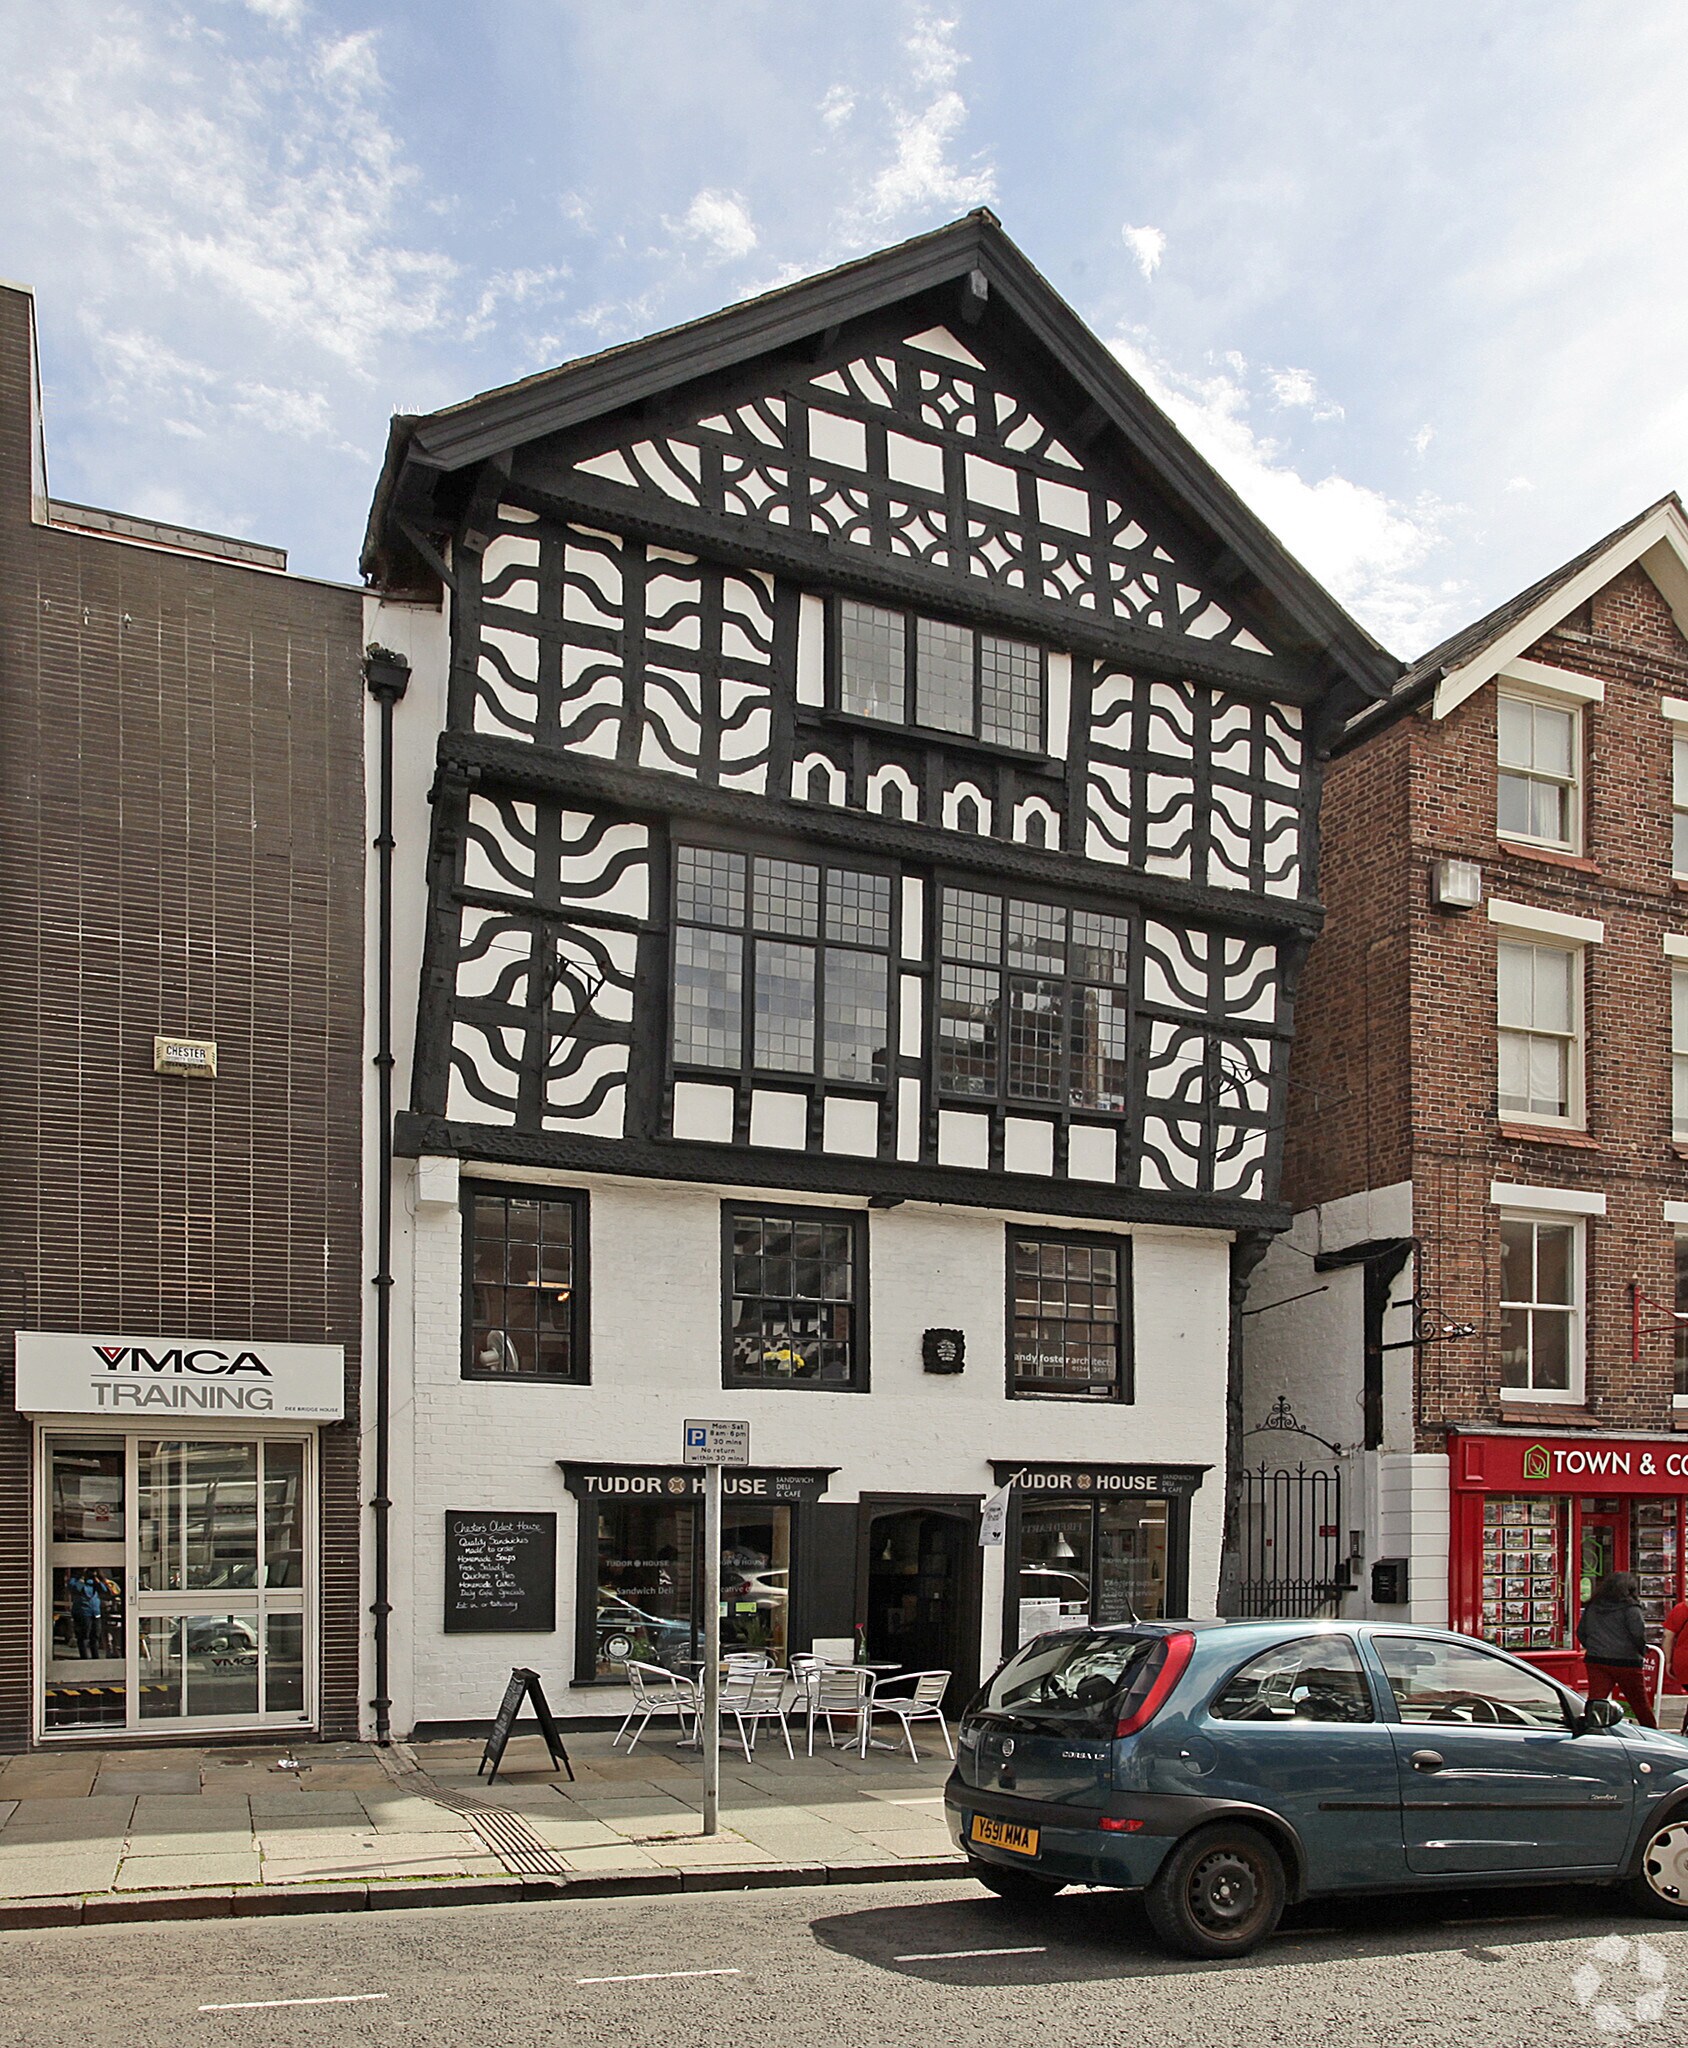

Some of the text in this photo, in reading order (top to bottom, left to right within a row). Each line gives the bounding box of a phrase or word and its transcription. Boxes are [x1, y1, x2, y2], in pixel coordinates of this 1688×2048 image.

[166, 1045, 206, 1058] CHESTER
[91, 1345, 273, 1377] YMCA
[1014, 1353, 1037, 1363] andy
[1040, 1354, 1070, 1363] foster
[90, 1383, 274, 1411] TRAINING
[1554, 1450, 1631, 1475] TOWN
[1639, 1453, 1656, 1475] &
[584, 1476, 767, 1495] TUDOR HUSE
[1009, 1473, 1157, 1490] TUDOR HOUSE
[454, 1520, 542, 1533] Chester's Oldest House
[459, 1535, 529, 1549] Quality Sandwiches
[457, 1555, 492, 1563] Homemade
[480, 1563, 505, 1571] Salads
[496, 1579, 516, 1588] Cakes
[617, 1586, 674, 1595] Sandwich Deli
[979, 1818, 1029, 1848] Y591 MMA
